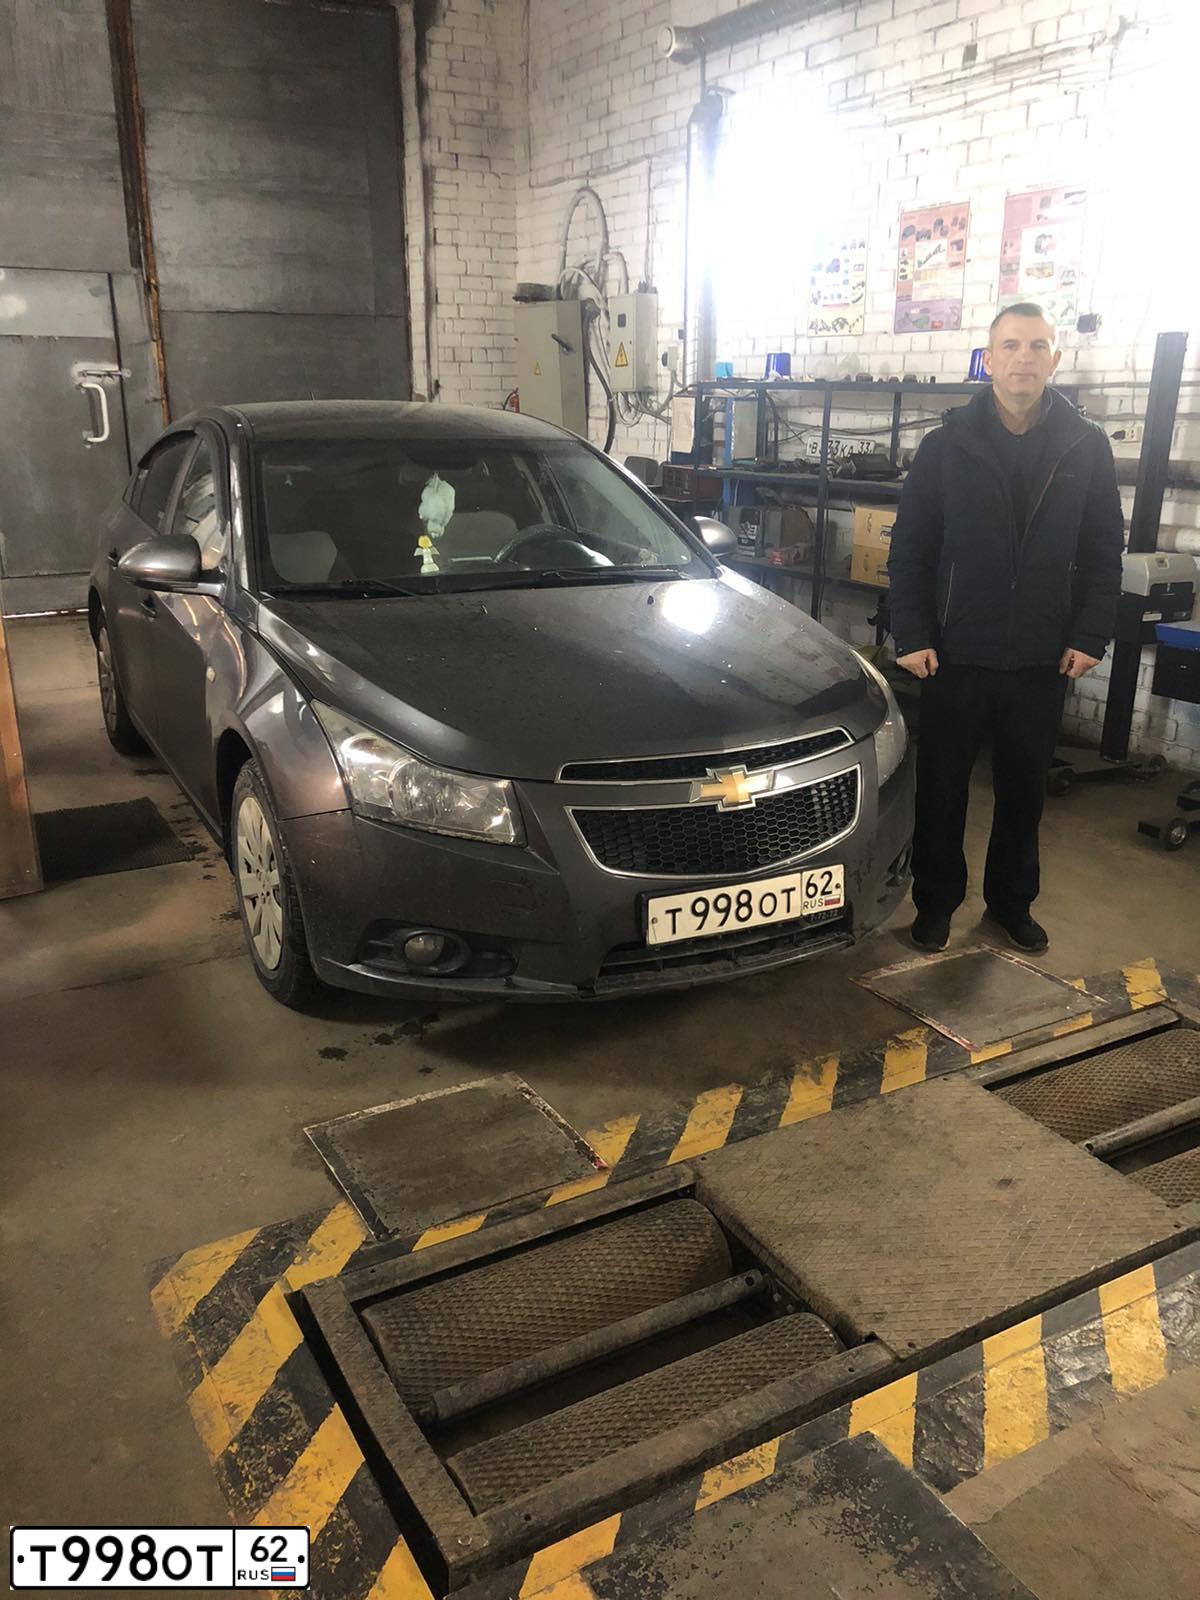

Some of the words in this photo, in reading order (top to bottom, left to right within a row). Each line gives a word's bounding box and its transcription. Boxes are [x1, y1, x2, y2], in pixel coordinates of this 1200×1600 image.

[665, 887, 796, 935] Т998ОТ
[805, 870, 833, 899] 62
[803, 898, 824, 911] RUS
